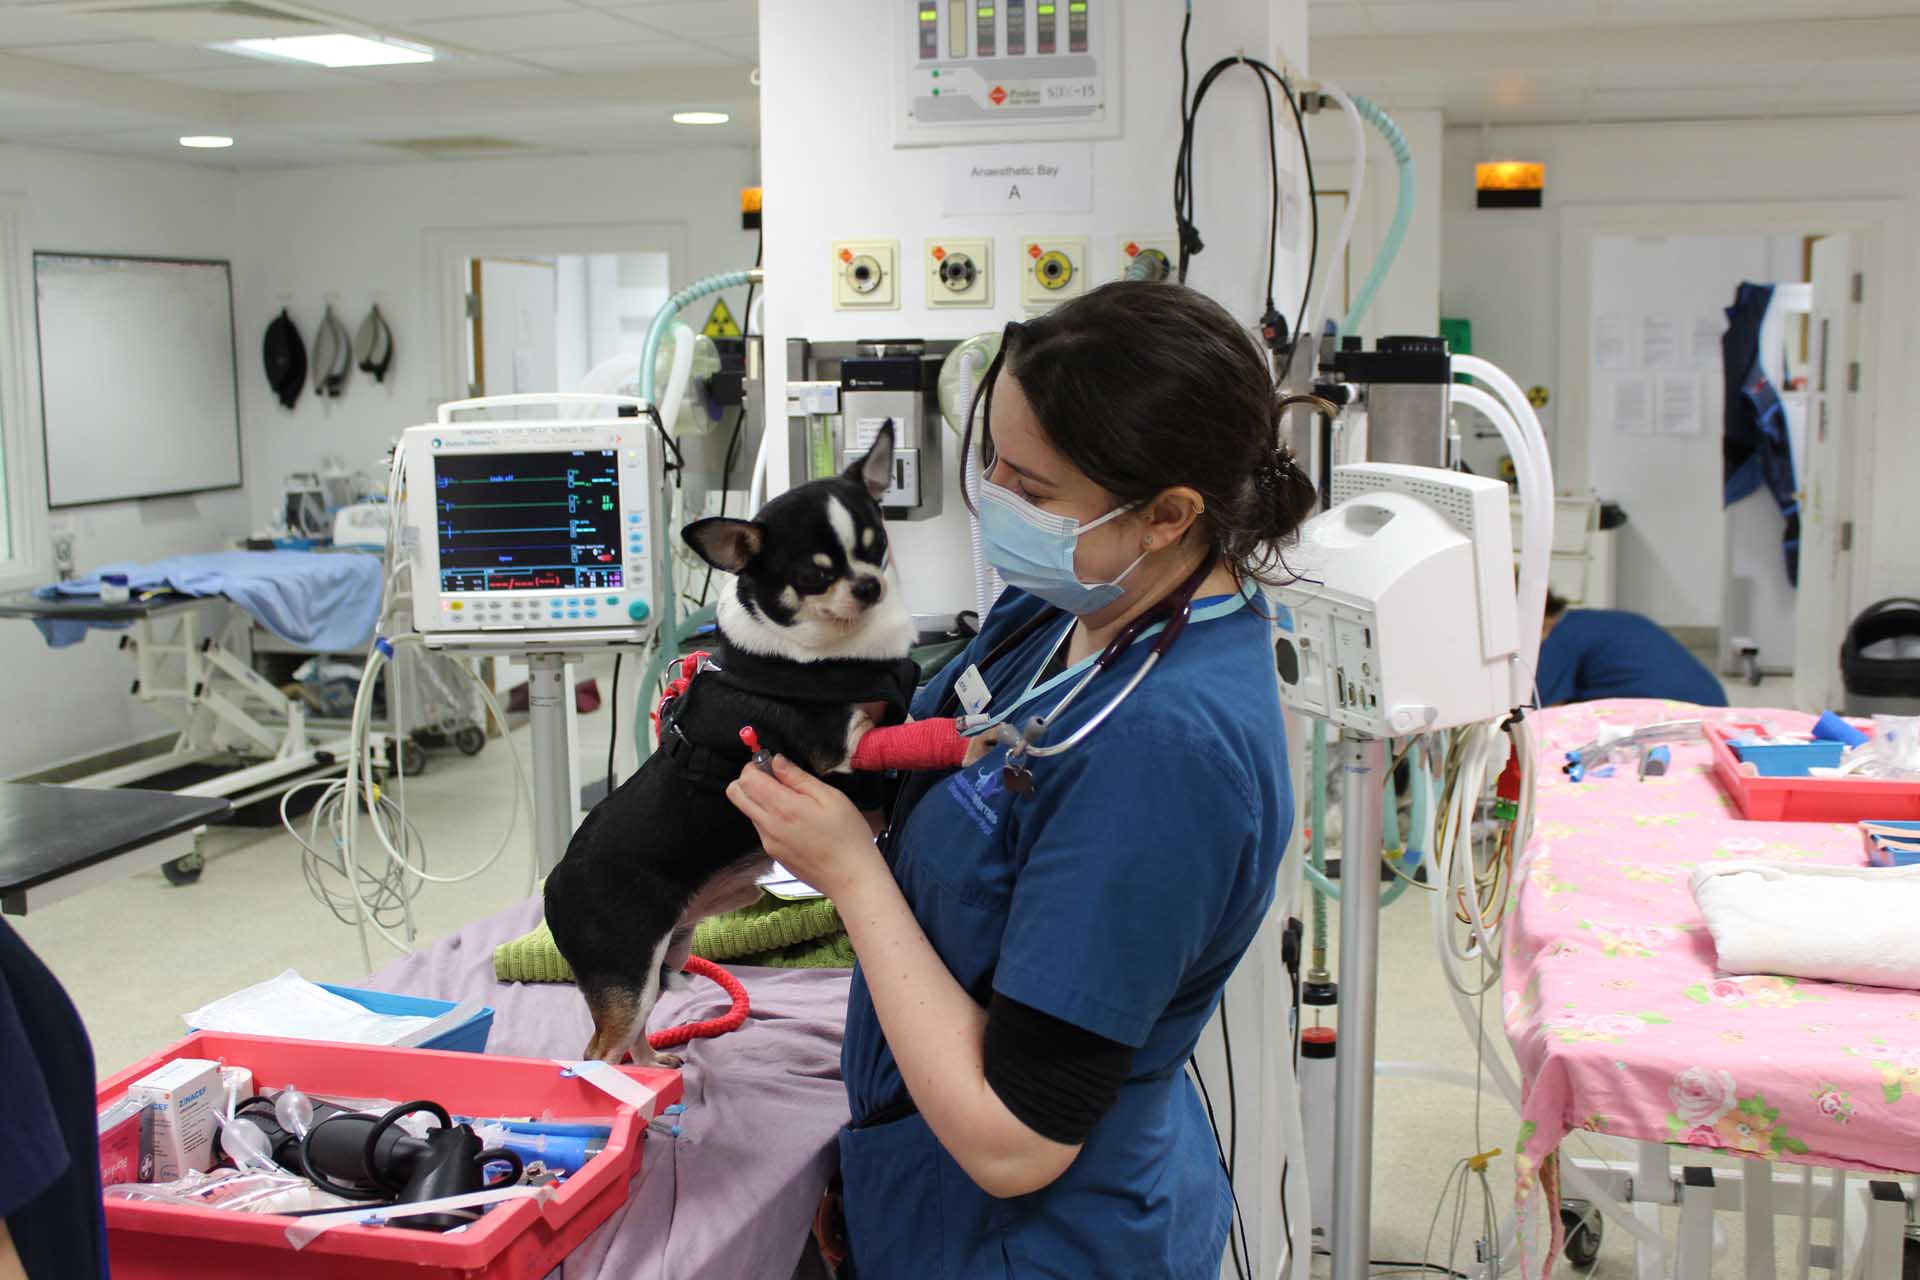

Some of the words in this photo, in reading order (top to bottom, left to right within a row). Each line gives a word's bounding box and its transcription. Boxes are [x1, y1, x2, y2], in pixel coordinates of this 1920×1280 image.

[971, 165, 1034, 178] Anaesthetic
[1037, 164, 1059, 178] Bay
[1008, 185, 1021, 200] A
[179, 1087, 208, 1108] ZINACEF
